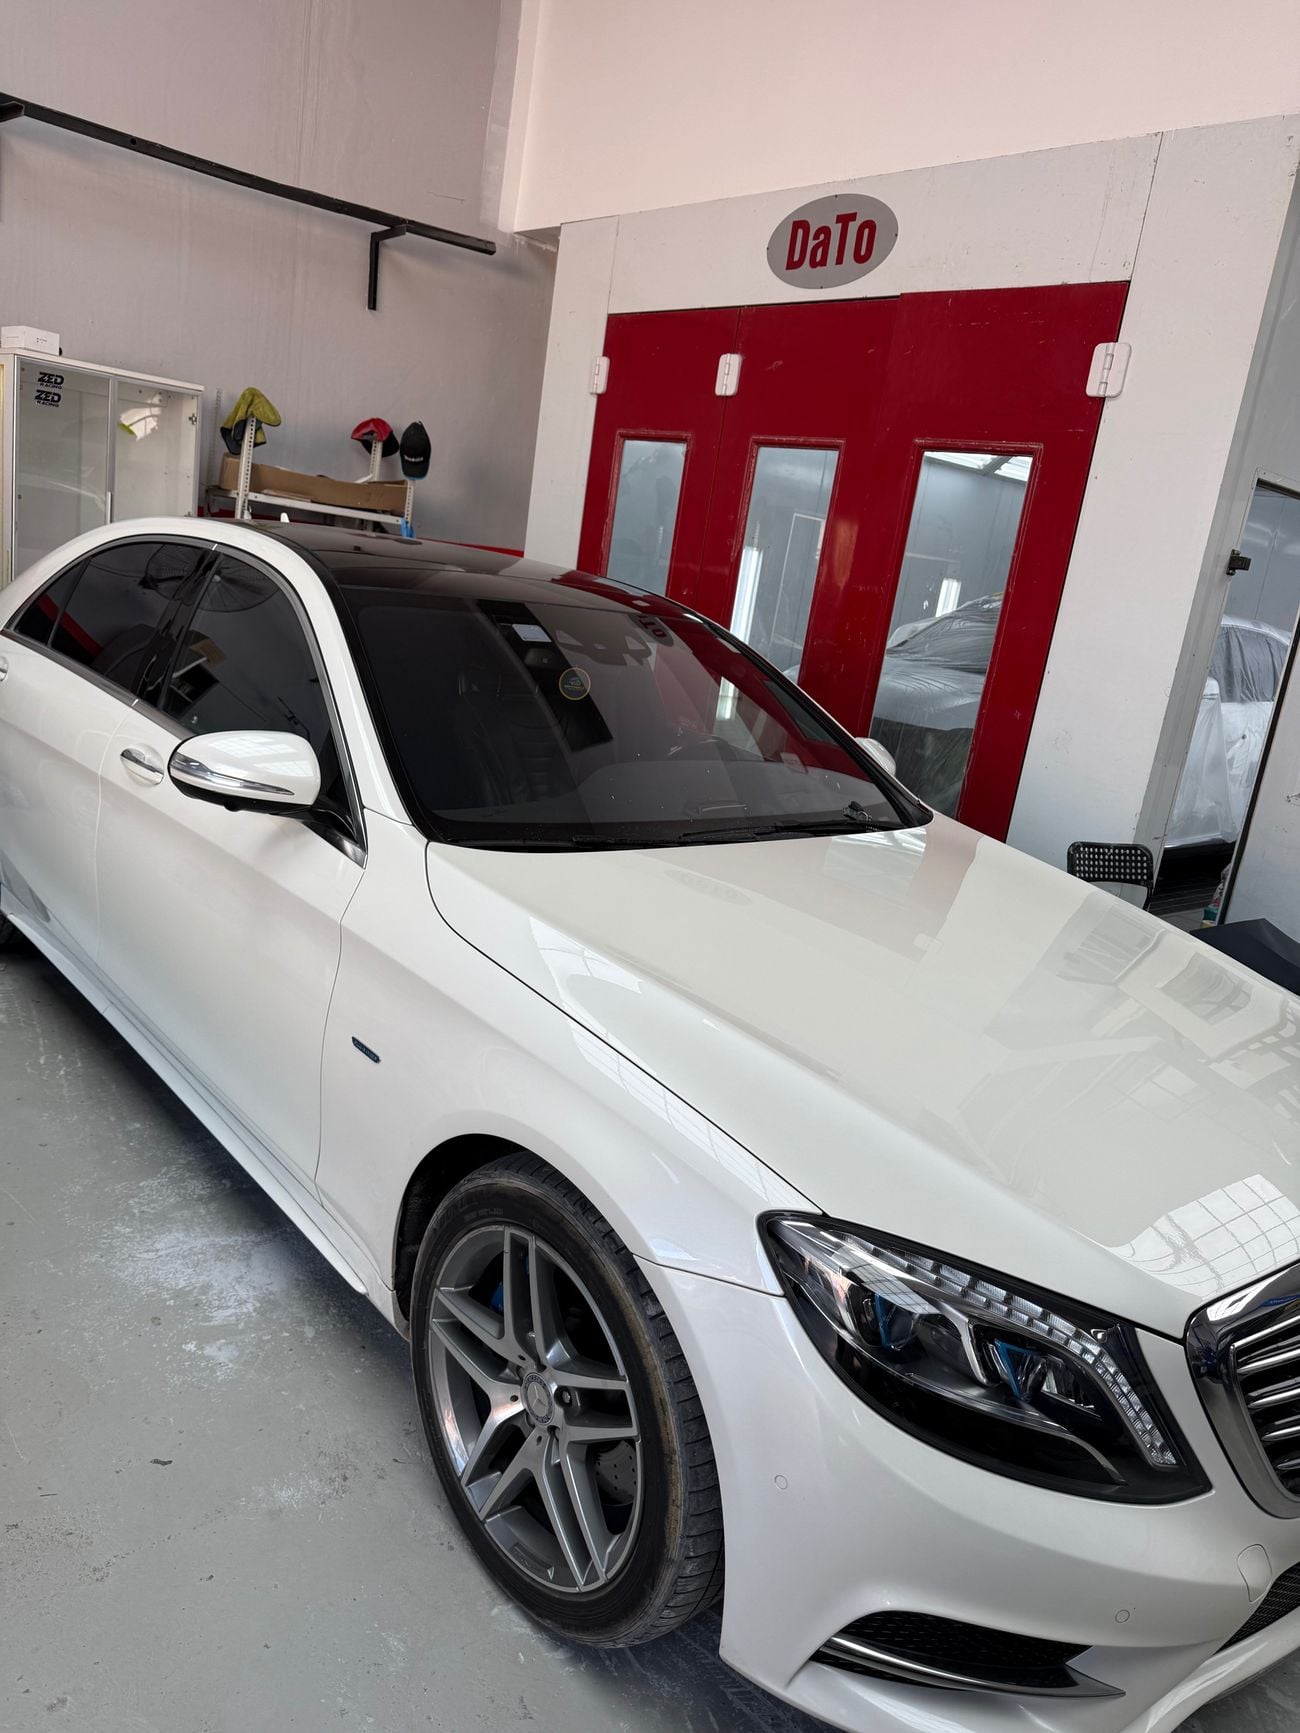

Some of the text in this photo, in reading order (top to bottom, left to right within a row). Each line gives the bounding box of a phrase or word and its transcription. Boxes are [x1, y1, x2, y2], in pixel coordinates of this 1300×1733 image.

[785, 211, 877, 271] DaTo
[38, 372, 64, 385] ZED
[35, 389, 61, 403] ZED
